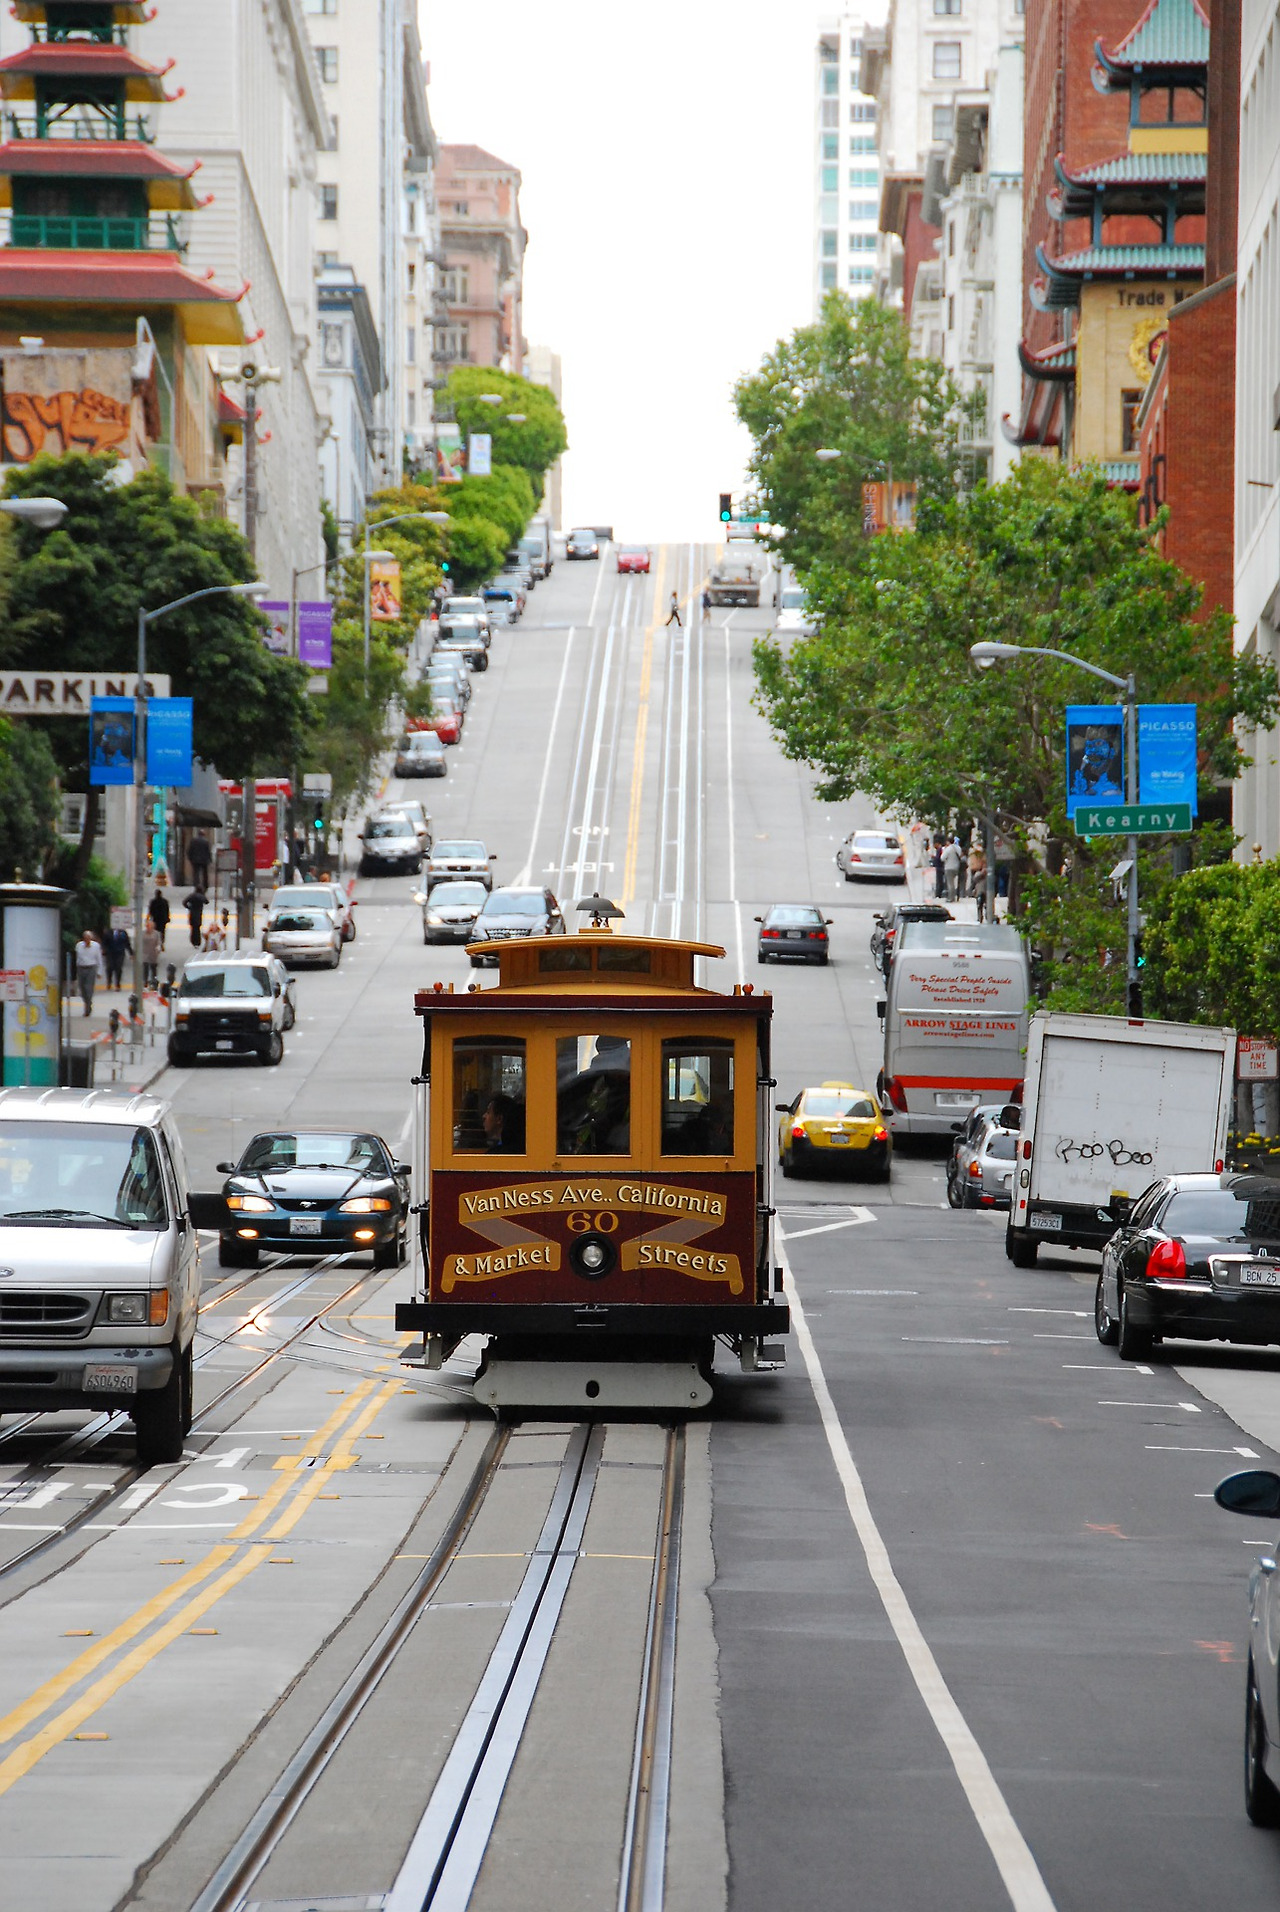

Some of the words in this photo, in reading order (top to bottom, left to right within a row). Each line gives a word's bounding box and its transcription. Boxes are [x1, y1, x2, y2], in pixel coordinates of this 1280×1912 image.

[1117, 289, 1165, 306] Trade
[863, 483, 878, 532] SHINE
[1140, 721, 1195, 730] PICASSO
[1088, 813, 1176, 828] Kearny
[909, 974, 926, 983] Very
[928, 974, 958, 984] Special
[960, 975, 986, 985] People
[988, 976, 1013, 985] Inside
[921, 984, 947, 993] Please
[949, 986, 971, 994] Drive
[972, 986, 999, 995] Safely
[904, 1019, 947, 1028] ARROW
[949, 1020, 982, 1029] STAGE
[985, 1022, 1016, 1031] LINES
[923, 1031, 995, 1039] arrowstagelines.com
[1250, 1052, 1266, 1060] ANY
[1250, 1061, 1267, 1070] TIME
[463, 1195, 501, 1215] Van
[501, 1188, 554, 1209] Ness
[617, 1184, 724, 1217] California
[566, 1211, 619, 1233] 60
[454, 1257, 471, 1276] &
[475, 1246, 552, 1275] Market
[639, 1245, 729, 1274] Streets
[1246, 1268, 1263, 1283] BCN
[87, 1375, 134, 1388] 6S04960
